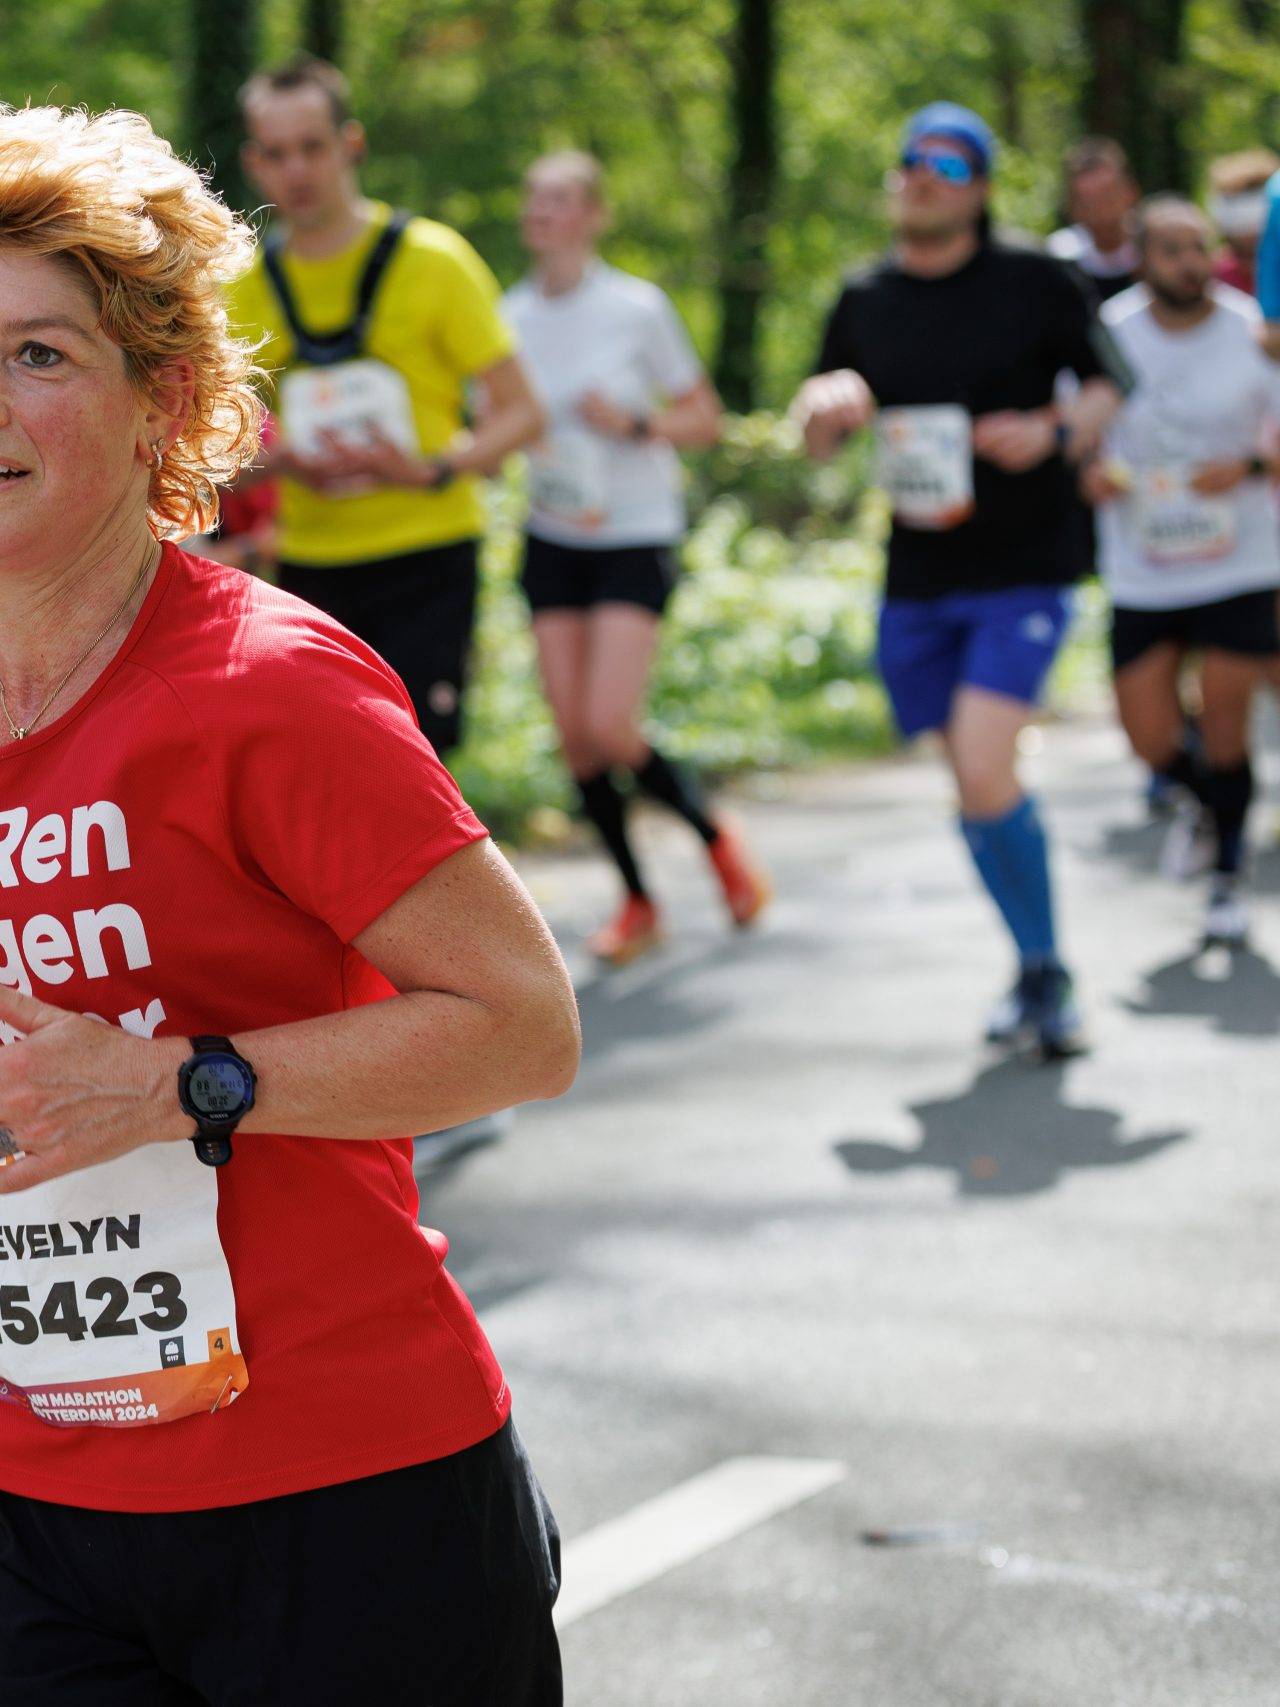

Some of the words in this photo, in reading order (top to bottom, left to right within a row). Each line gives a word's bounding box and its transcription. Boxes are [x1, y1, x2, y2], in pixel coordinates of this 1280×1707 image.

[213, 1337, 224, 1350] 4
[49, 1387, 143, 1407] MARATHON
[115, 1403, 159, 1422] 2024
